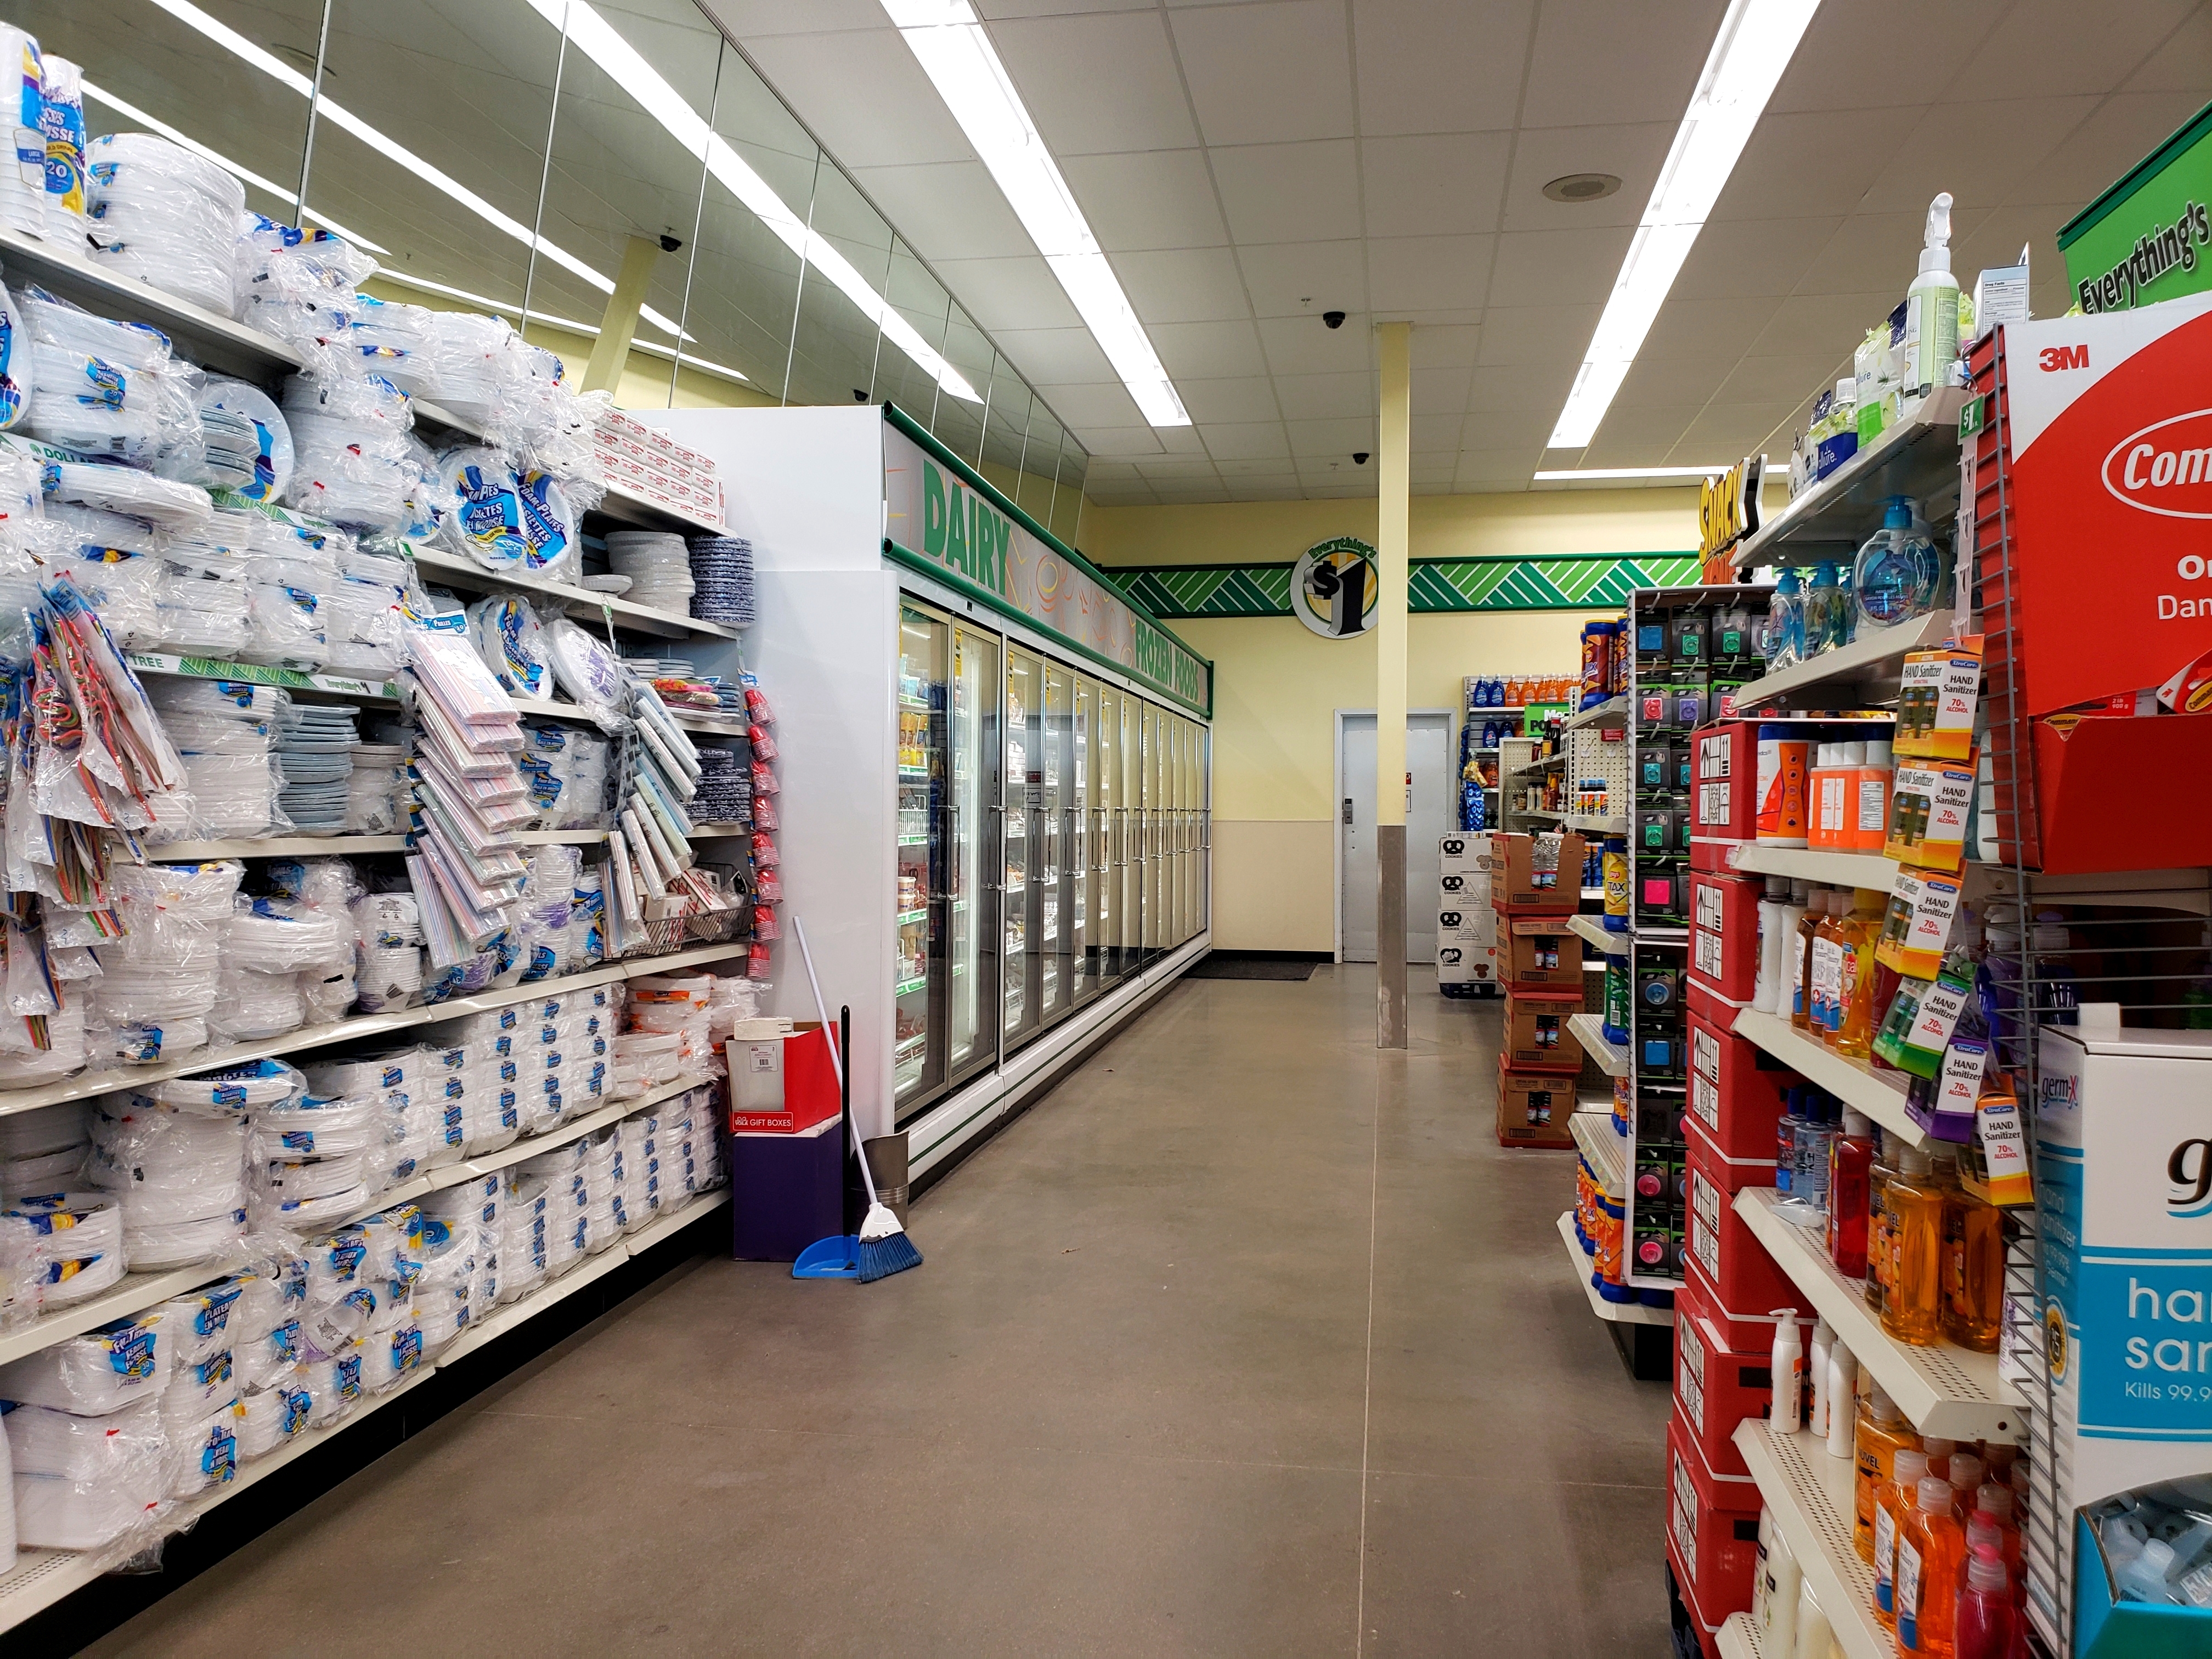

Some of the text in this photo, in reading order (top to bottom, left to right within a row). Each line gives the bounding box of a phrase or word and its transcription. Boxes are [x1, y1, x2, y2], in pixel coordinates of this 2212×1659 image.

[47, 161, 67, 177] 20
[2078, 200, 2210, 314] Everything's
[2039, 345, 2089, 373] 3M
[1963, 404, 1976, 431] $1
[43, 447, 94, 464] DOLLA
[518, 482, 565, 533] FOAM PLATES
[1699, 460, 1745, 565] SNACK
[923, 459, 1011, 597] DAIRY
[1308, 537, 1377, 559] Everything's
[1304, 557, 1367, 636] $1
[132, 654, 165, 669] TREE
[1136, 618, 1198, 703] FROZEN FOODS
[1951, 659, 1978, 668] XtraCare
[1904, 664, 1943, 679] HAND Sanitizer
[1950, 675, 1973, 685] HAND
[1943, 684, 1977, 696] Sanitizer
[2161, 687, 2174, 698] 3M
[1951, 698, 1966, 707] 70%
[1898, 770, 1935, 787] HAND Sanitizer
[1944, 771, 1971, 781] XtraCare
[1942, 786, 1966, 797] HAND
[1934, 795, 1970, 808] Sanitizer
[1942, 810, 1957, 819] 70%
[1937, 817, 1960, 826] ALCOHOL
[1928, 882, 1956, 894] XtraCare
[1925, 896, 1949, 909] HAND
[1917, 904, 1953, 919] Sanitizer
[1923, 919, 1938, 929] 70%
[1917, 926, 1941, 936] ALCOHOL
[1939, 981, 1964, 995] XtraCare
[1932, 995, 1957, 1011] HAND
[1923, 1002, 1958, 1022] Sanitizer
[1921, 1024, 1944, 1037] ALCOHOL
[1928, 1018, 1943, 1030] 70%
[1956, 1044, 1984, 1055] XtraCare
[1953, 1059, 1978, 1070] HAND
[1946, 1067, 1982, 1081] Sanitizer
[1948, 1089, 1972, 1098] ALCOHOL
[1954, 1082, 1969, 1092] 70%
[1989, 1121, 2013, 1131] HAND
[1984, 1131, 2021, 1141] Sanitizer
[1997, 1145, 2013, 1153] 70%
[2129, 1277, 2212, 1323] ha
[2125, 1381, 2212, 1402] Kills 99.9
